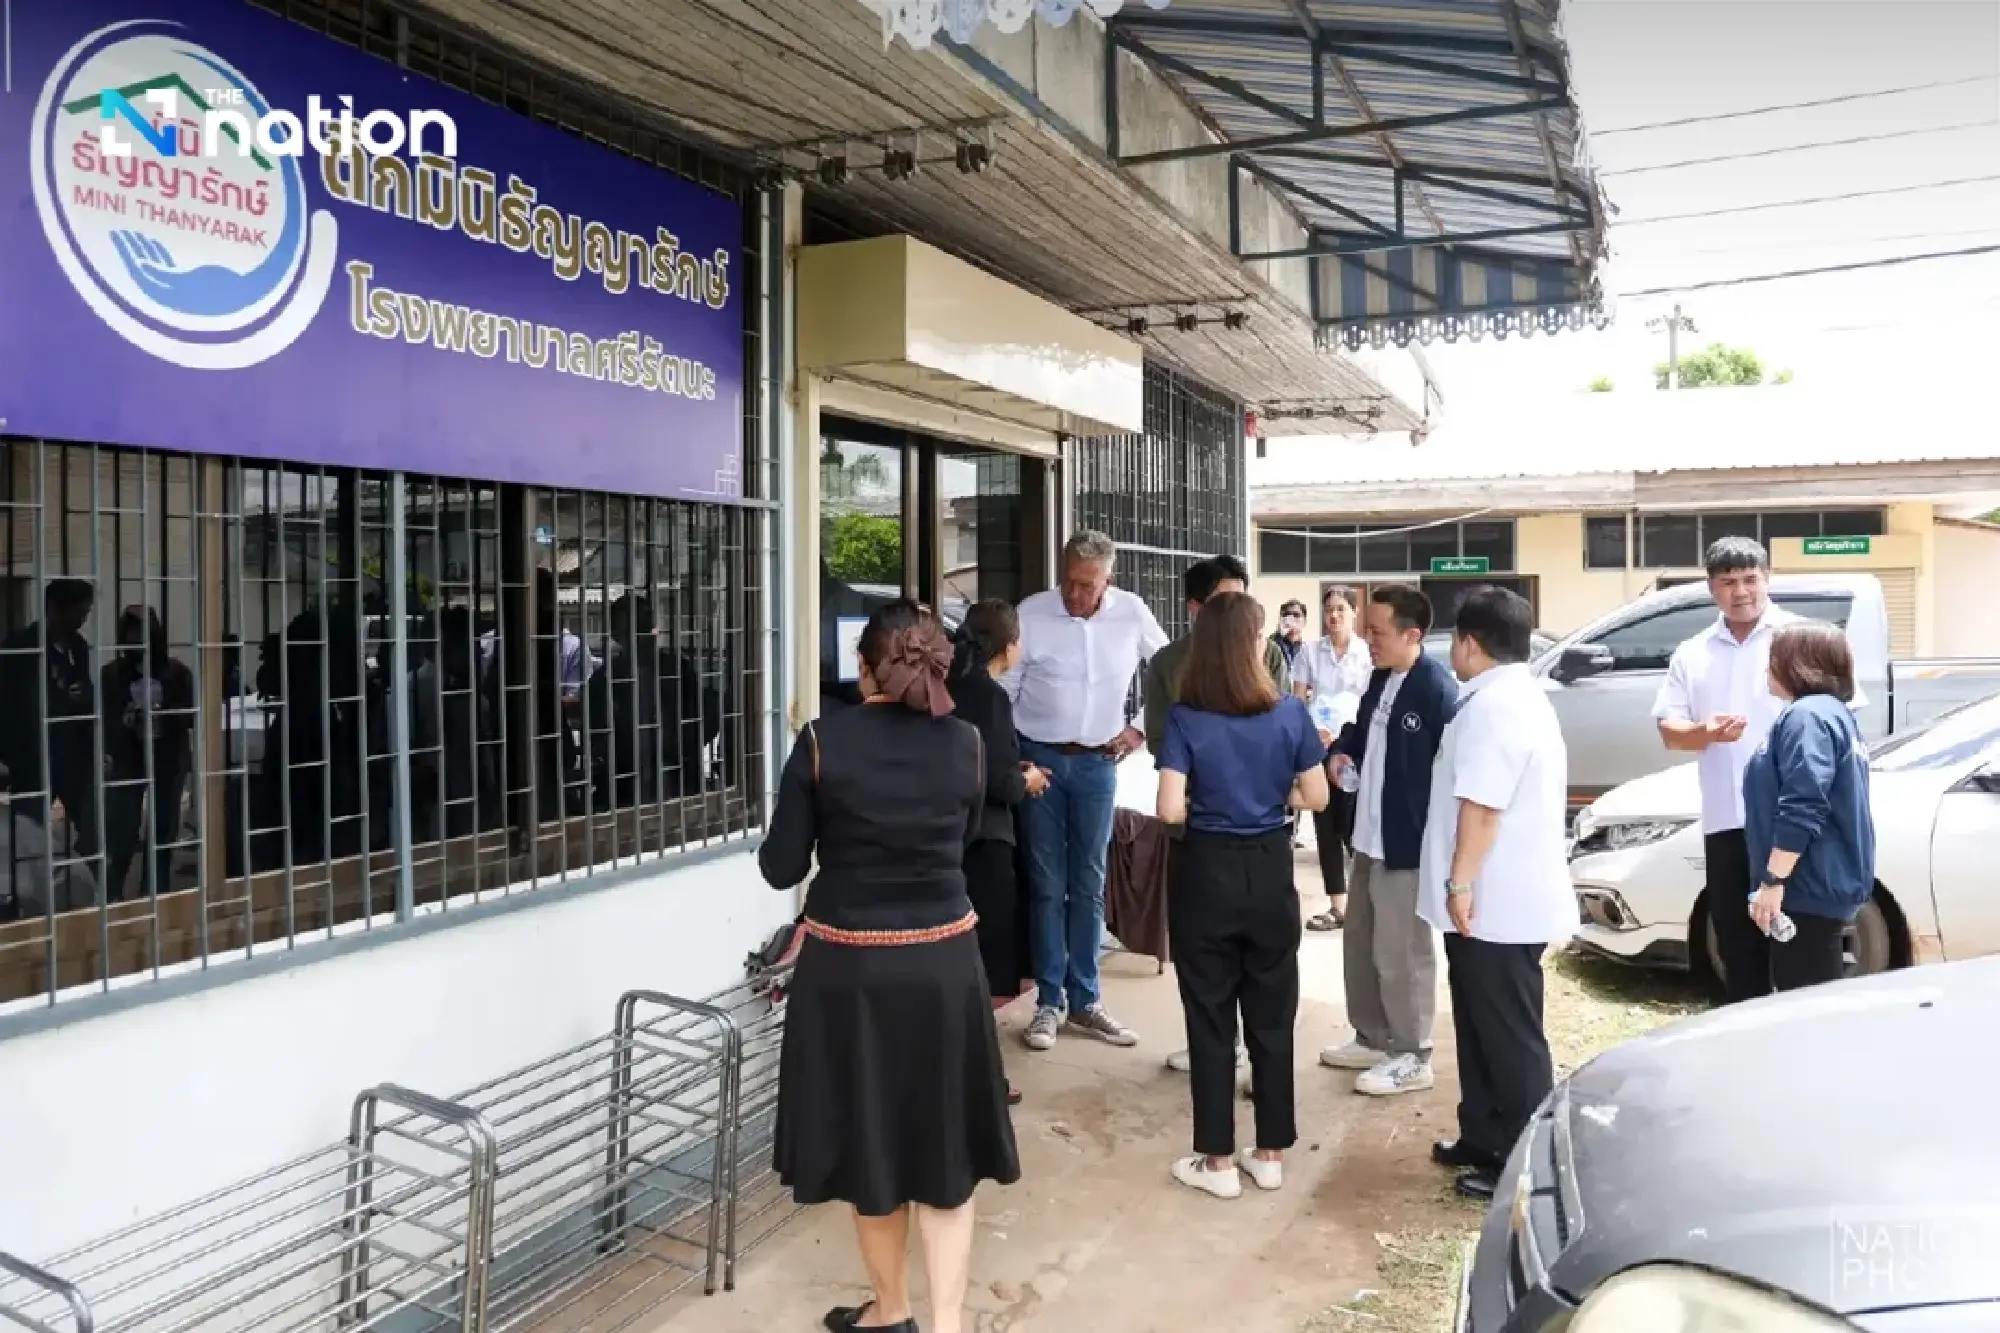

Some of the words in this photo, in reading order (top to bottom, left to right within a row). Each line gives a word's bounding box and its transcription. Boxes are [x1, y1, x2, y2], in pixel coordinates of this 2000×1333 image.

[73, 184, 127, 215] MINI
[136, 198, 268, 249] THANYARAK
[345, 259, 717, 401] โรงพยาบาลศรีรัตนะ
